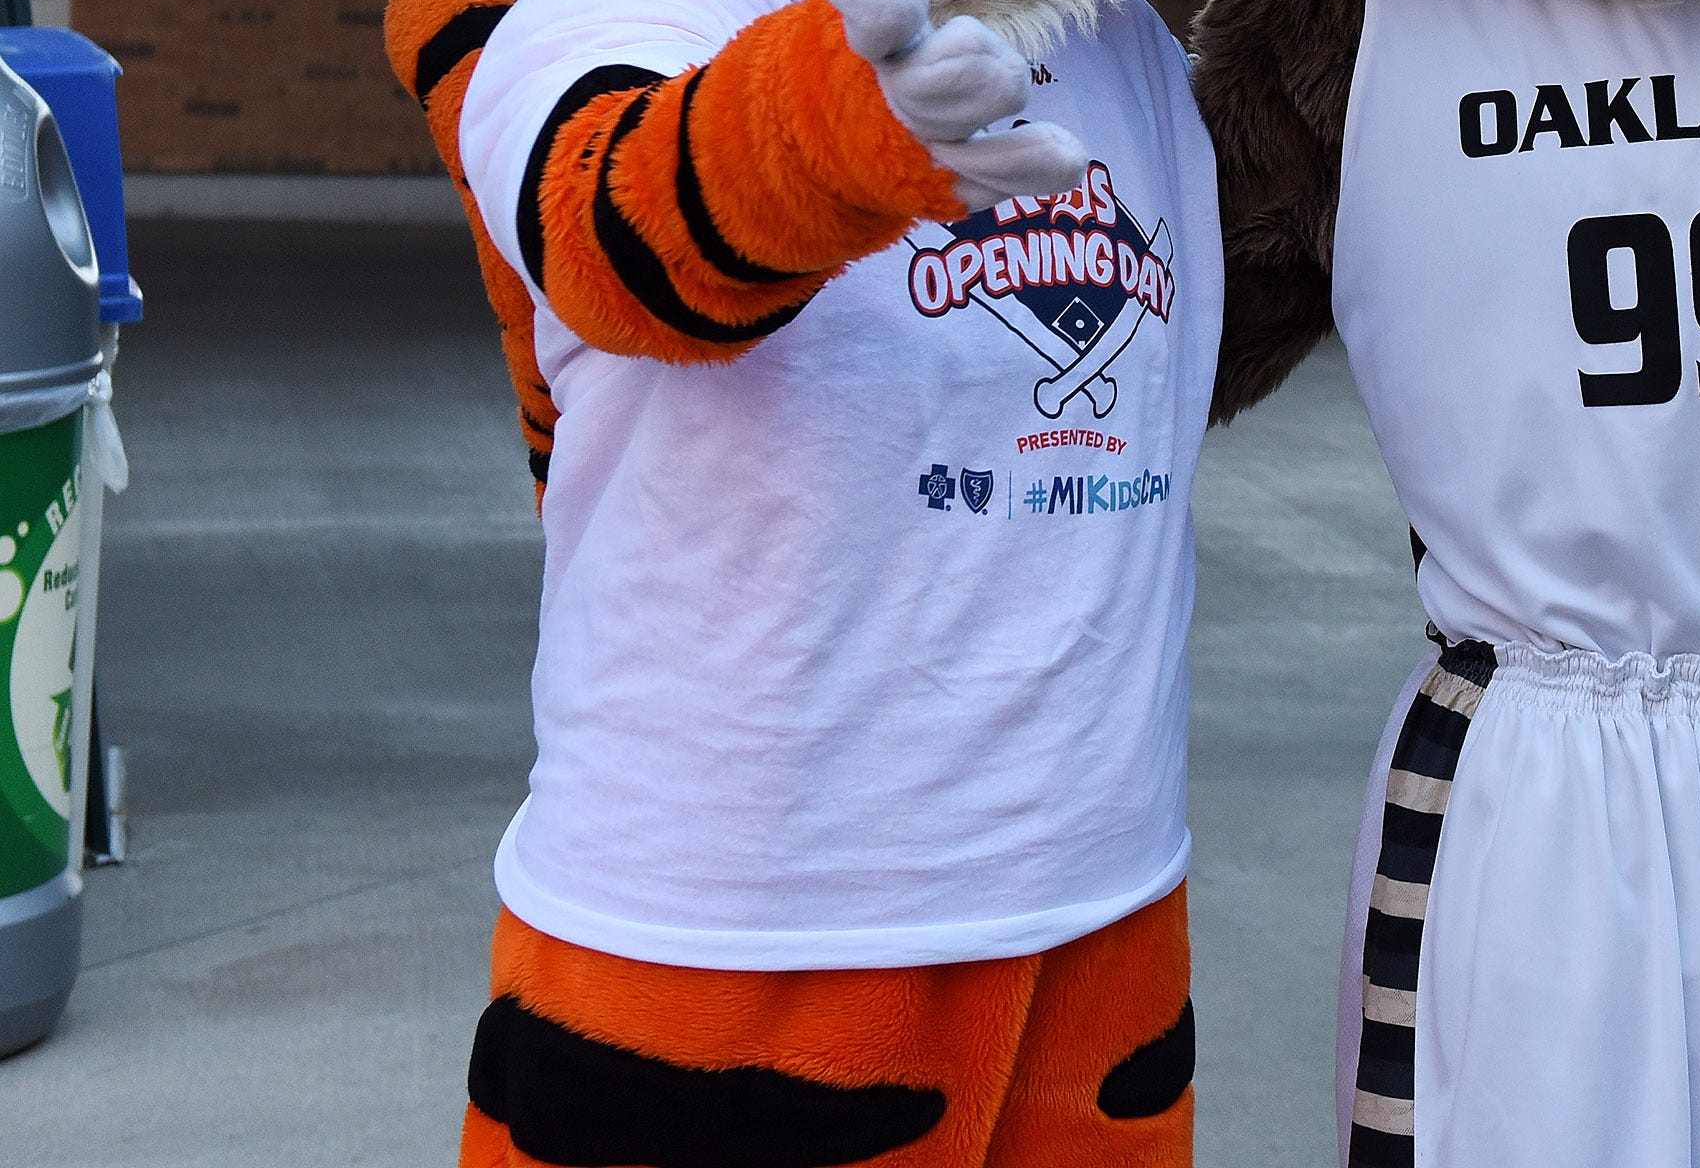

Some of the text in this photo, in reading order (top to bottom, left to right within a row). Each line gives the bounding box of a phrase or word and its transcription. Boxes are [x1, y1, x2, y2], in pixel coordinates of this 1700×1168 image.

[911, 229, 1174, 323] OPENING DAY
[1016, 429, 1128, 456] PRESENTED BY
